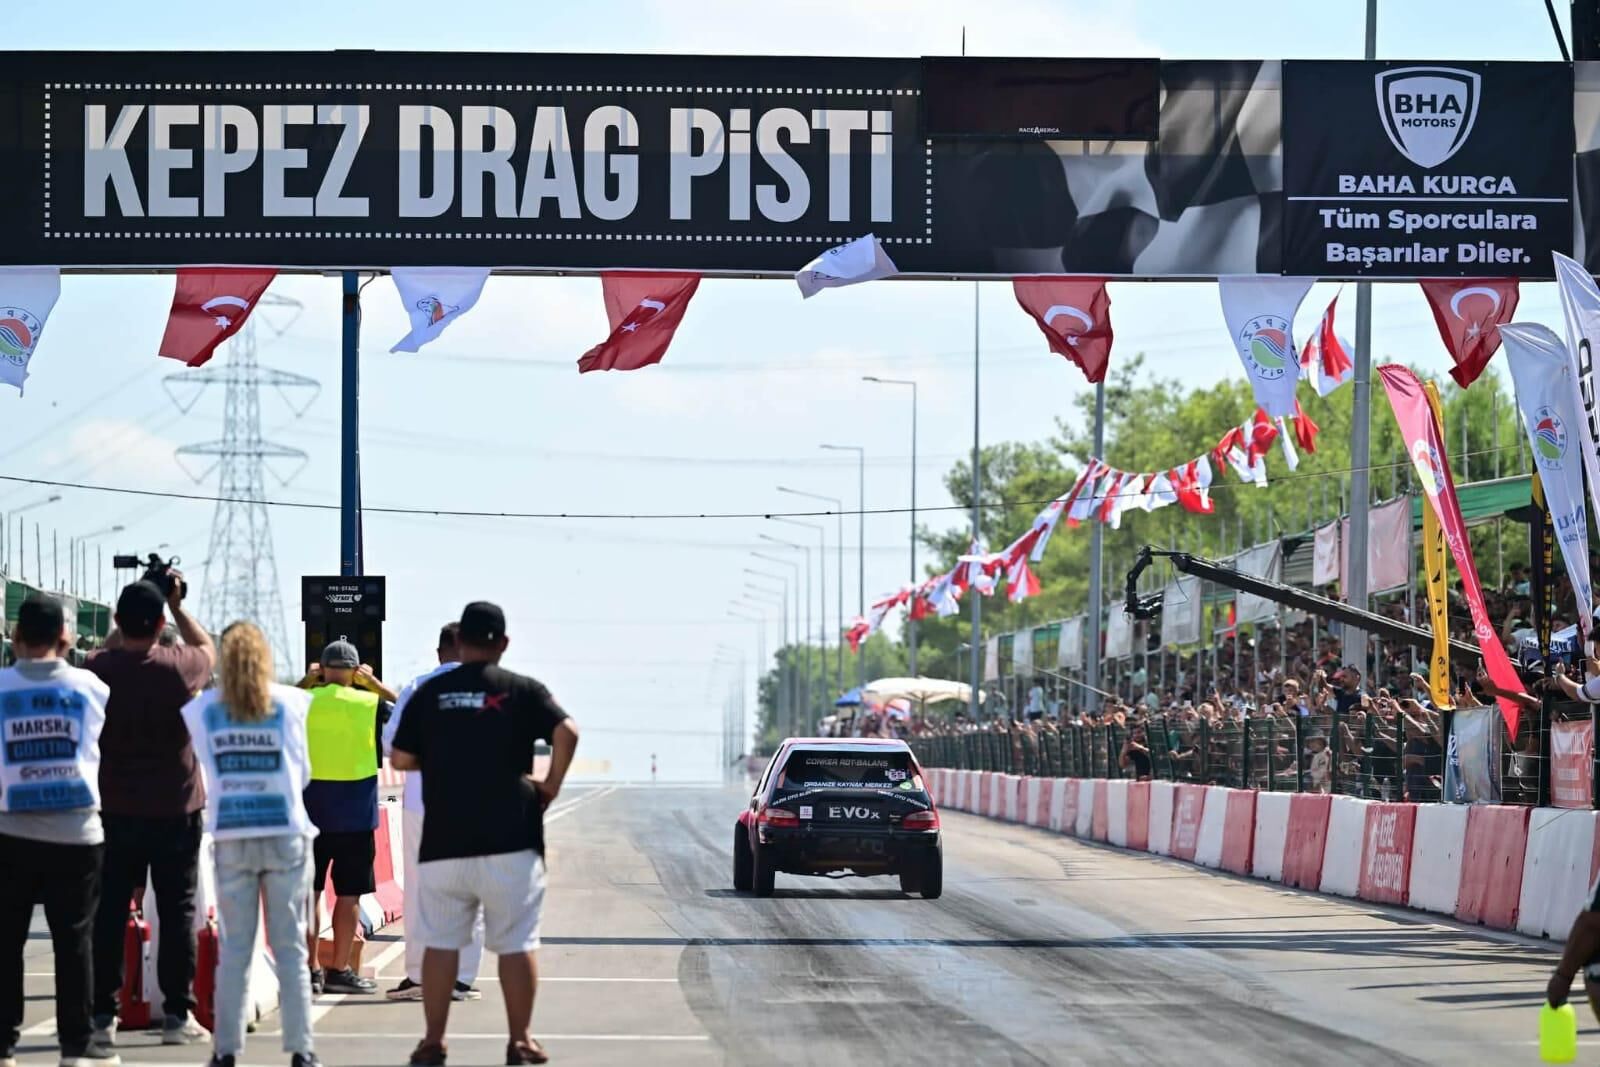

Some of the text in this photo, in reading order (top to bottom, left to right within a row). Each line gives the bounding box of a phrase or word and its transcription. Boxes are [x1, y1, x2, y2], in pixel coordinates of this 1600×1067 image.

[1395, 94, 1462, 114] BHA
[1401, 118, 1456, 128] MOTORS
[83, 104, 370, 218] KEPEZ
[398, 105, 640, 220] DRAG
[1338, 175, 1517, 195] BAHA KURGA
[1319, 207, 1537, 234] Tüm Sporculara
[1326, 241, 1531, 268] Başarılar Diler.
